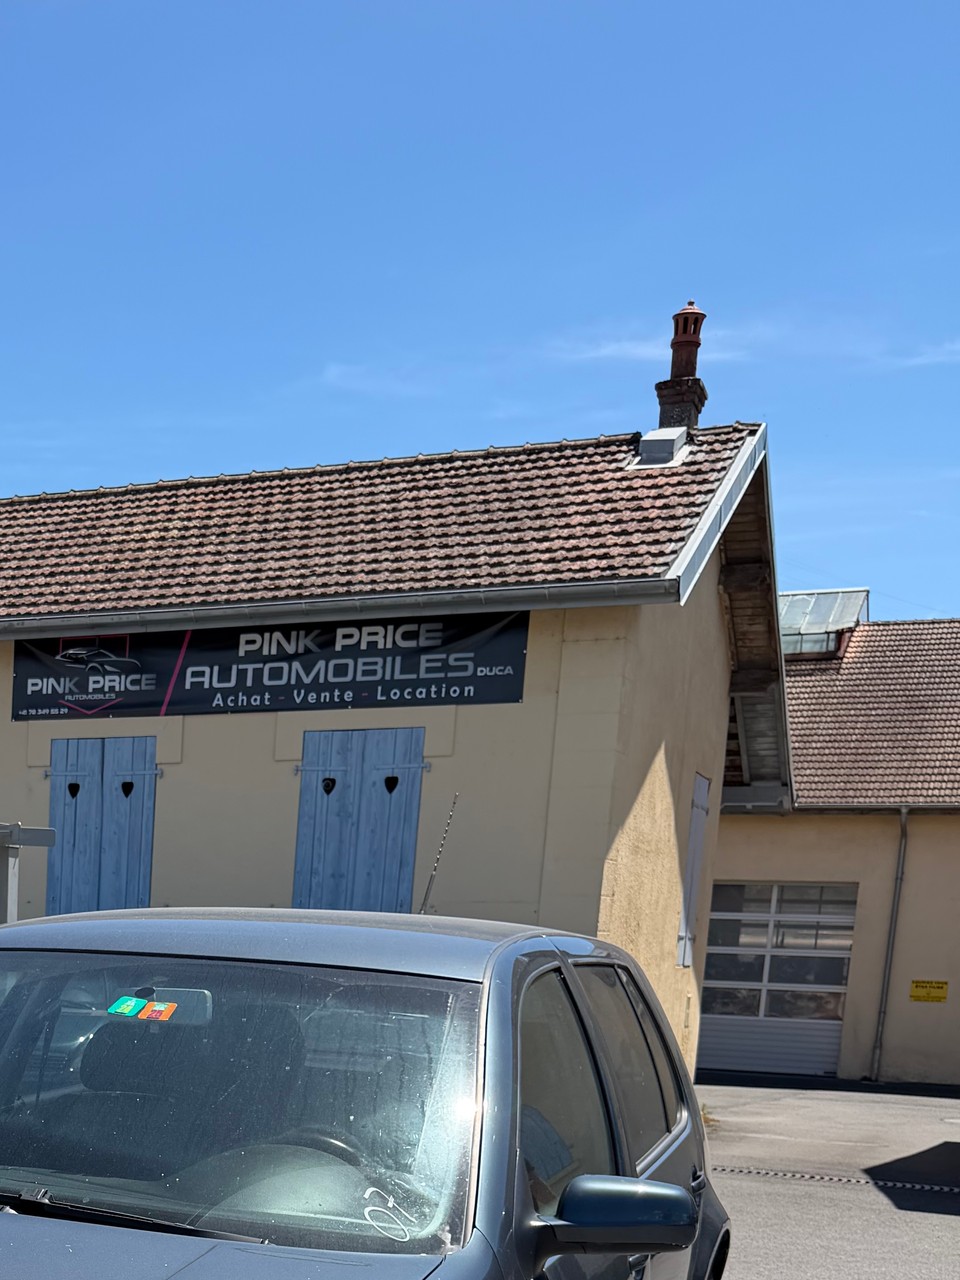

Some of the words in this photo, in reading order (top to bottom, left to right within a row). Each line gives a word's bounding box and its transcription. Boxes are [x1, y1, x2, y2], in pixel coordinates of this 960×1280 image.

[238, 629, 321, 657] PINK
[334, 622, 443, 652] PRICE
[184, 652, 475, 690] AUTOMOBILES
[476, 665, 514, 676] DUCA
[26, 677, 79, 695] PINK
[88, 673, 157, 693] PRICE
[212, 691, 271, 708] Achat
[293, 688, 353, 704] Vente
[376, 683, 474, 700] Location
[64, 693, 116, 701] AUTOMOBILES
